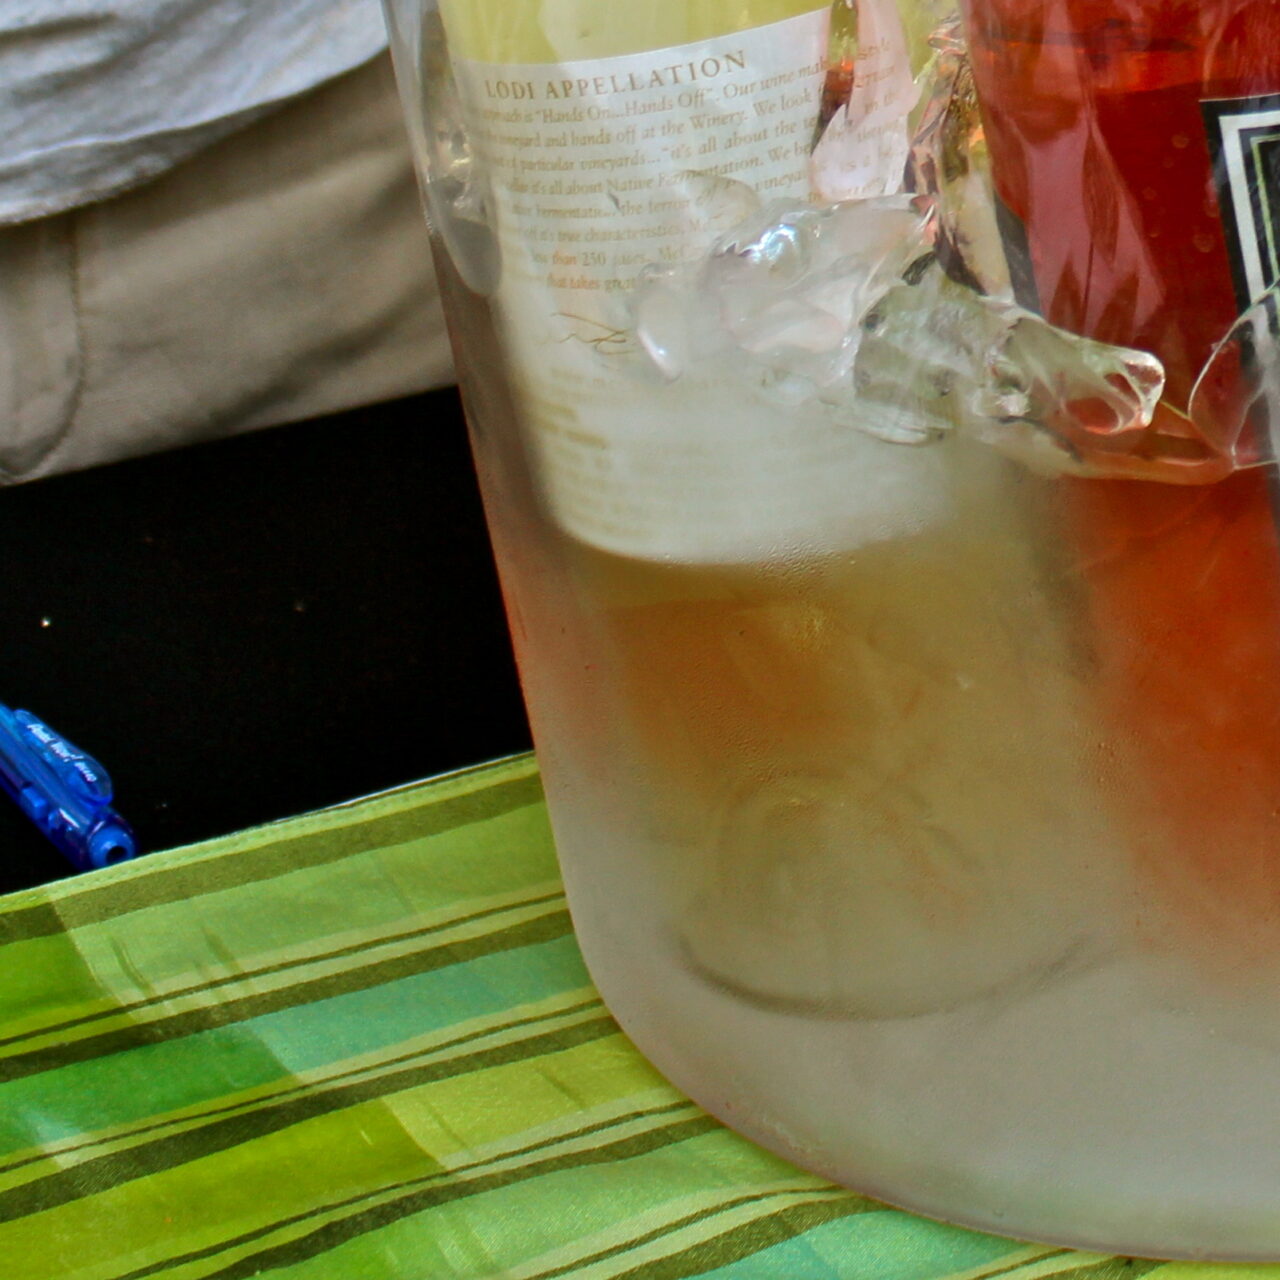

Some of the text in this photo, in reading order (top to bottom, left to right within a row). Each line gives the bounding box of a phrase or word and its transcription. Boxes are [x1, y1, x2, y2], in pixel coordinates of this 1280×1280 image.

[484, 50, 747, 100] LODI APPELLATION
[723, 81, 758, 100] Our
[760, 70, 795, 91] wine
[571, 127, 611, 146] hands
[616, 123, 637, 145] off
[642, 127, 656, 139] at
[660, 119, 685, 136] the
[689, 110, 748, 130] Winery.
[753, 99, 777, 117] We
[780, 88, 812, 112] look
[698, 135, 718, 155] all
[724, 128, 769, 150] about
[775, 119, 798, 136] the
[566, 178, 604, 195] about
[606, 175, 654, 193] Native
[768, 146, 792, 163] We
[581, 251, 607, 268] 250
